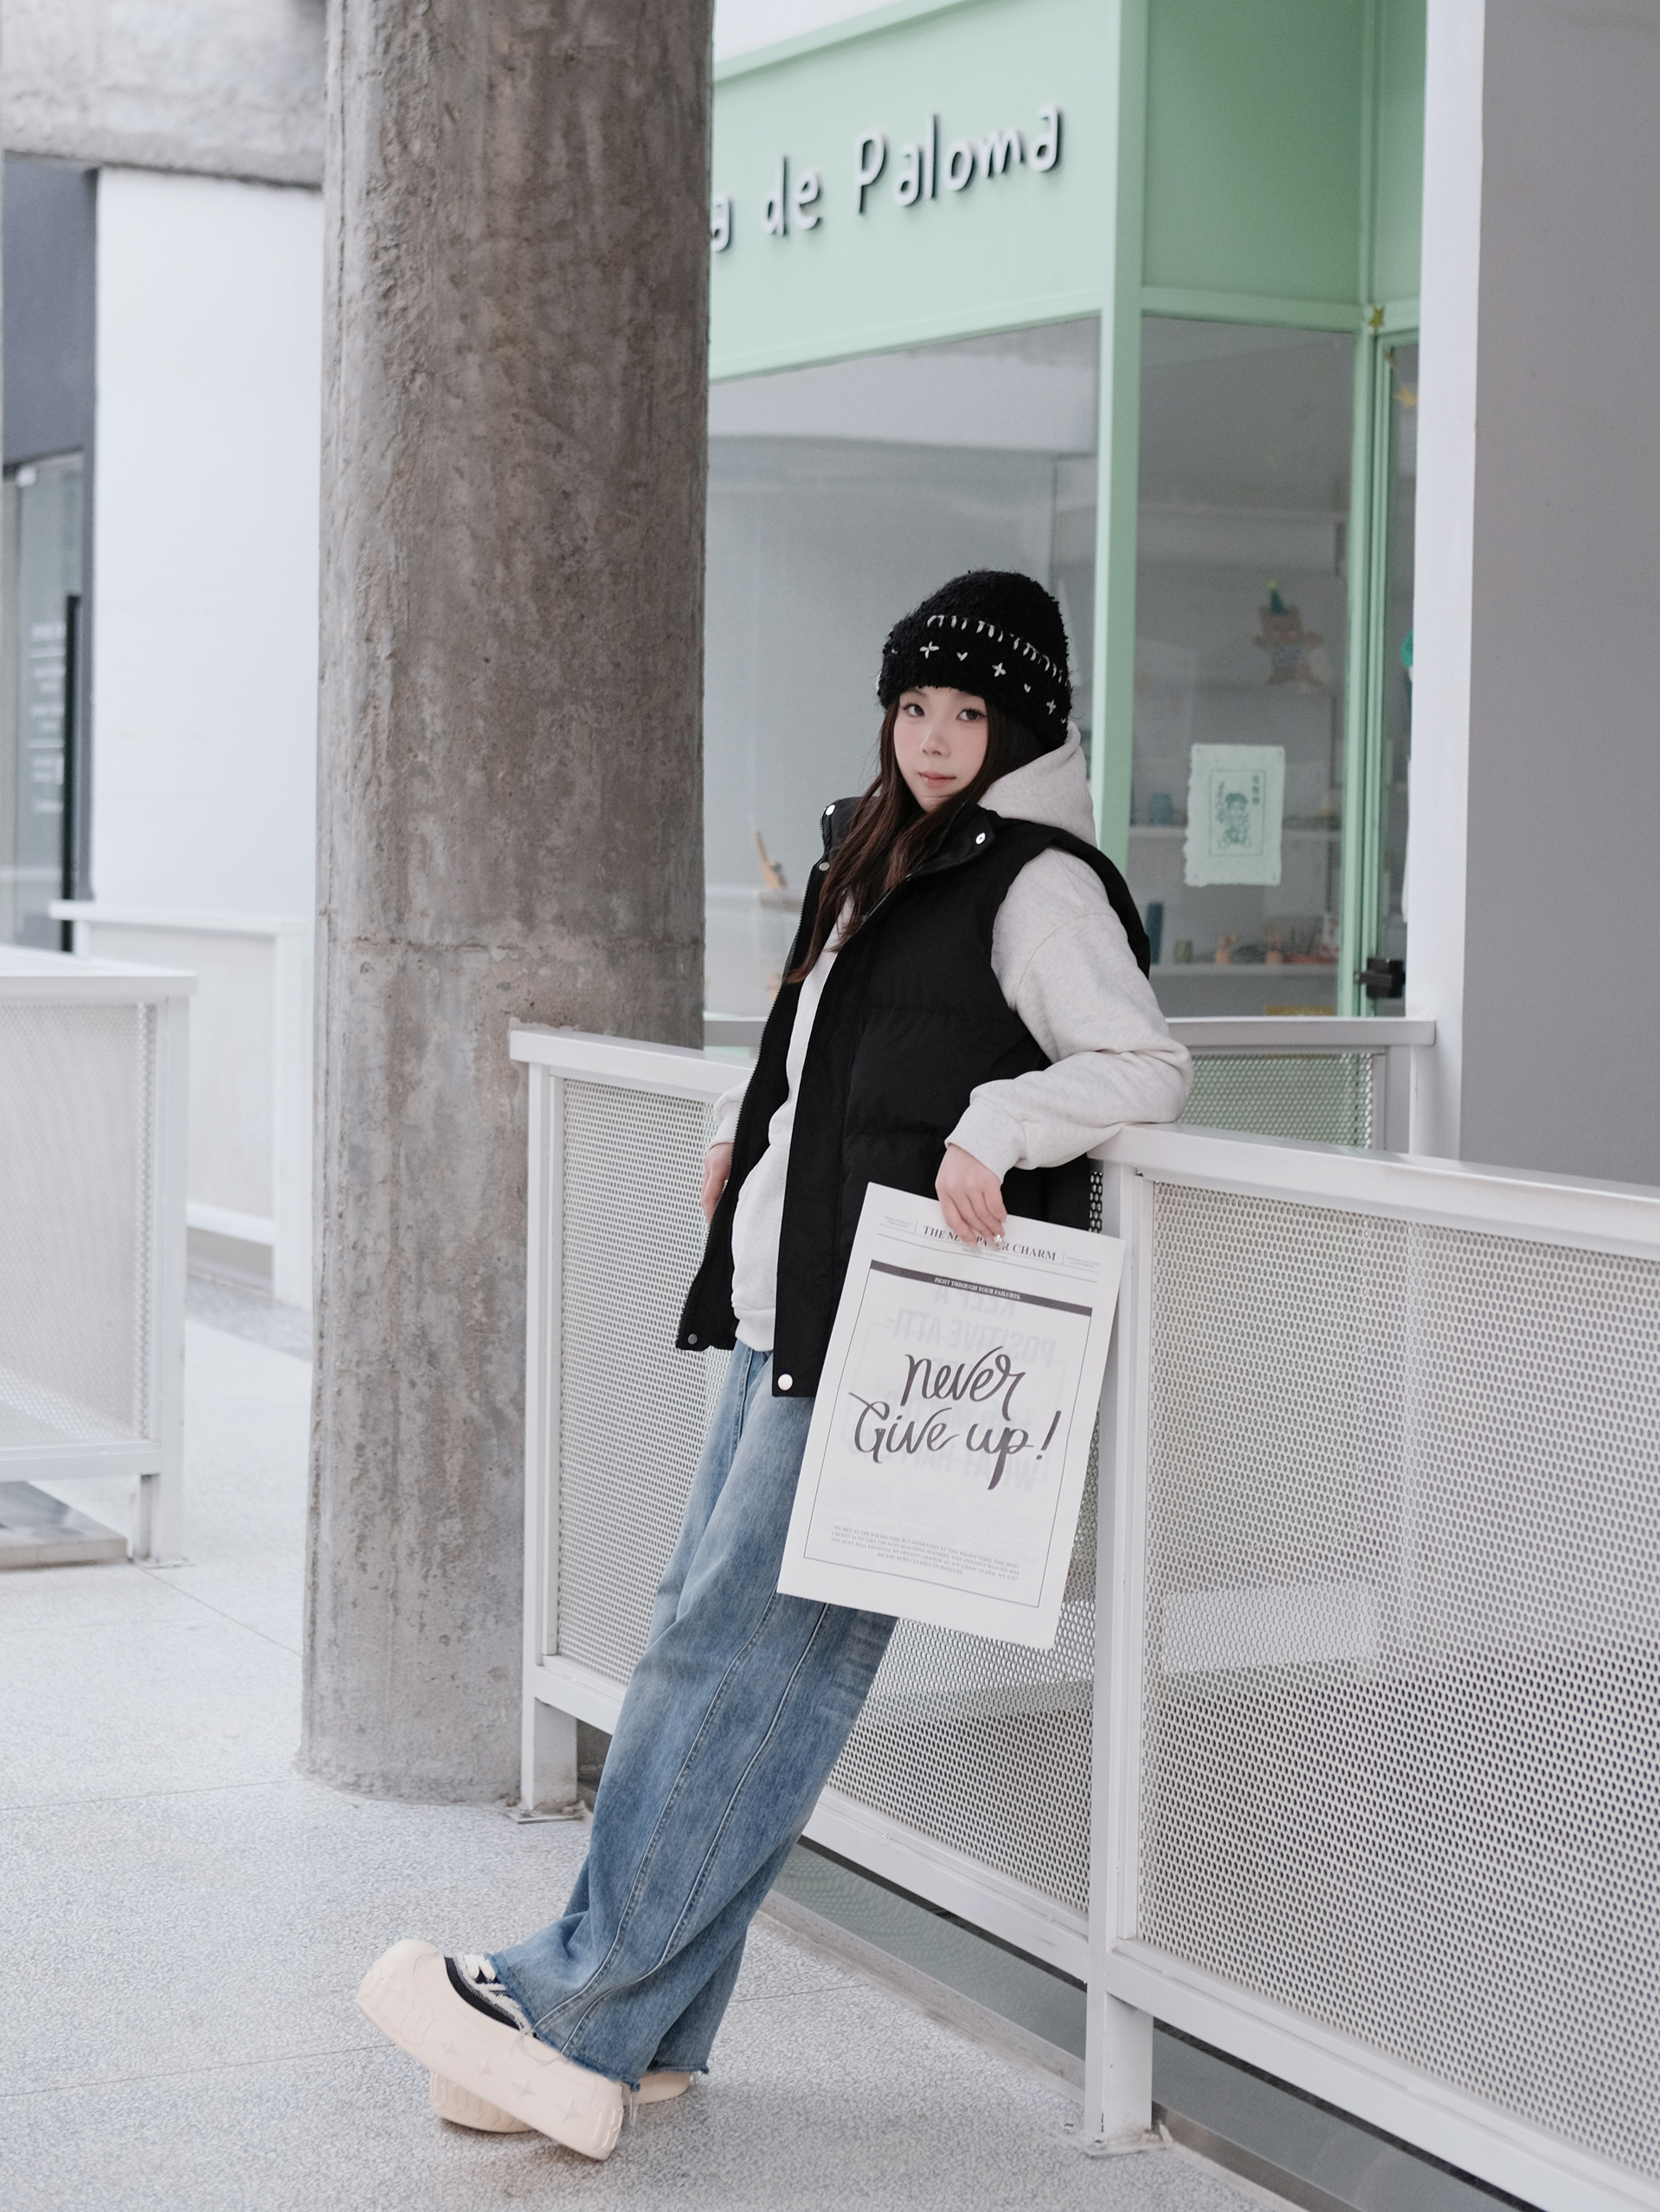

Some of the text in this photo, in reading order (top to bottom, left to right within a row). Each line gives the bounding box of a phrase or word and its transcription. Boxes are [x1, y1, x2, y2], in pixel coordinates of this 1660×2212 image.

[764, 156, 822, 236] de
[854, 103, 1065, 215] Paloma
[923, 1225, 946, 1238] THE
[947, 1231, 1010, 1251] NEPAR
[1013, 1244, 1057, 1261] CHARM
[950, 1280, 977, 1291] THROUGH
[978, 1285, 994, 1294] YOUR
[900, 1346, 1026, 1421] never
[848, 1392, 960, 1463] Give
[966, 1411, 1062, 1490] up!
